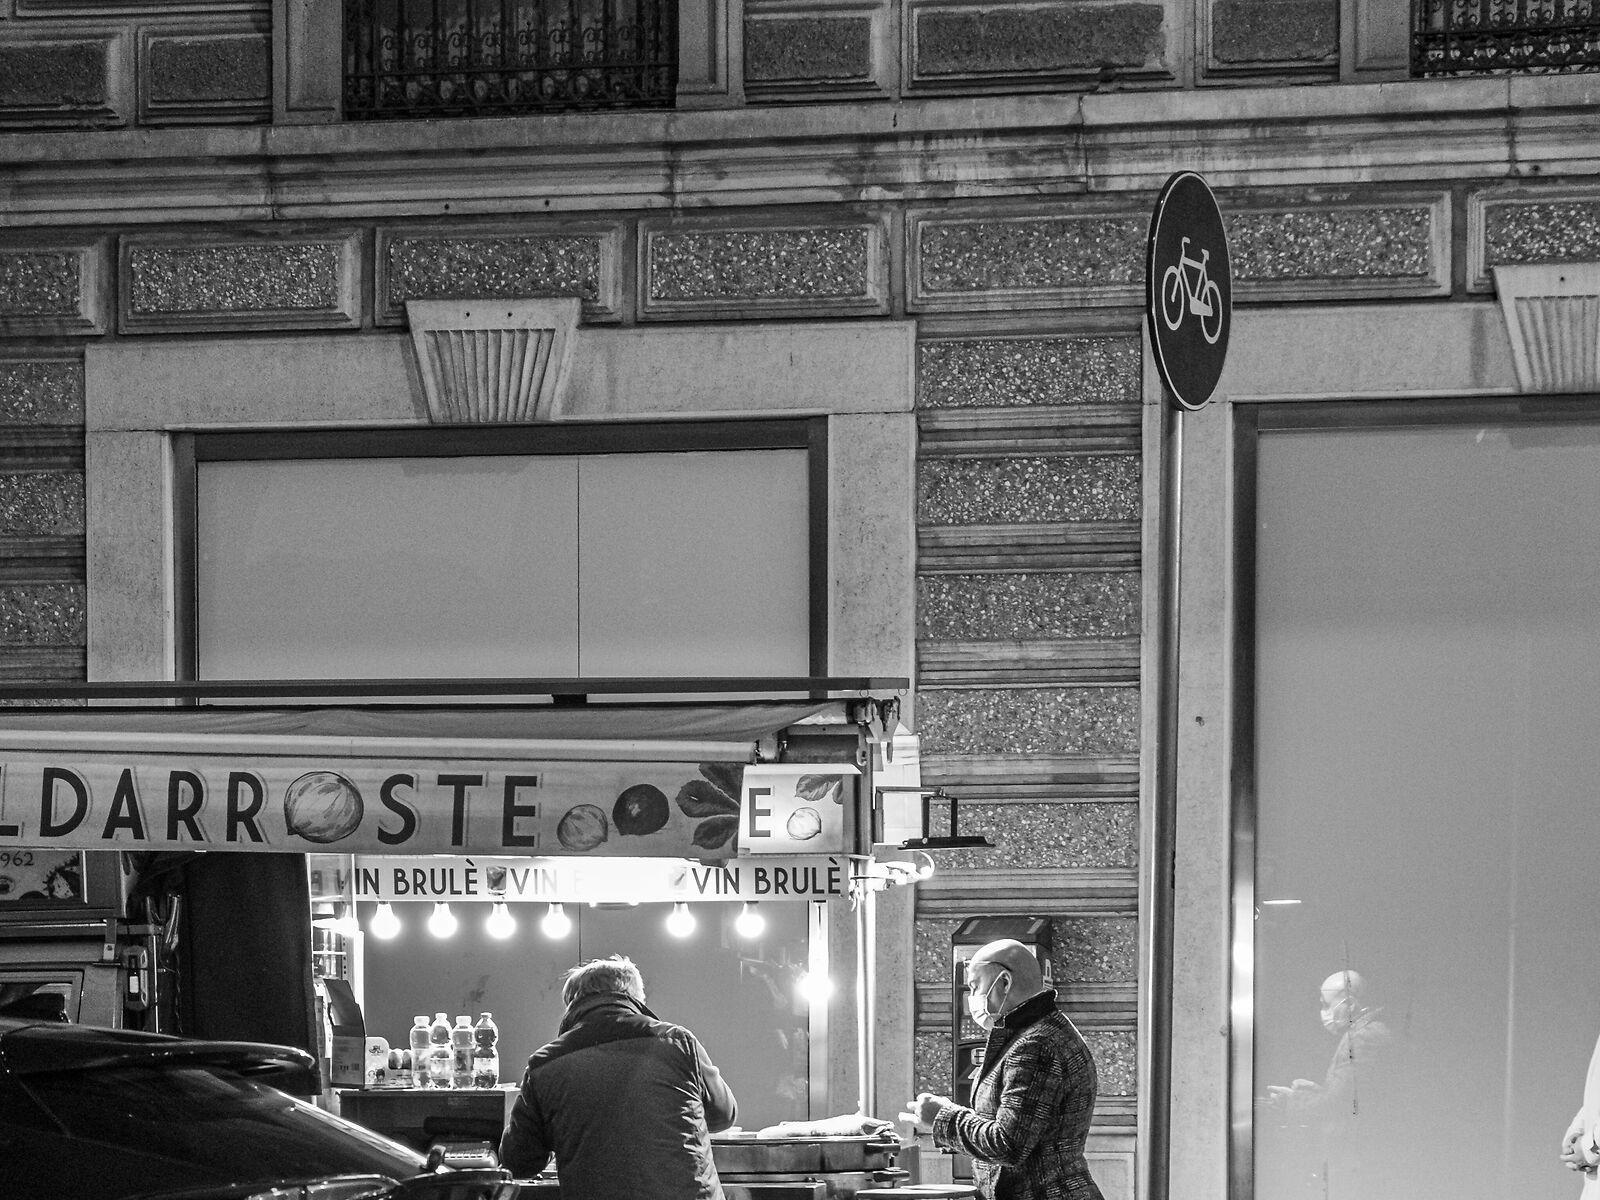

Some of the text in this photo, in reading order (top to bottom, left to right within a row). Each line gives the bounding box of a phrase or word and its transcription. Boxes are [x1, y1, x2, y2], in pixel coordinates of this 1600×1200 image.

[394, 858, 478, 895] BRULÈ
[692, 857, 841, 894] VIN BRULÈ
